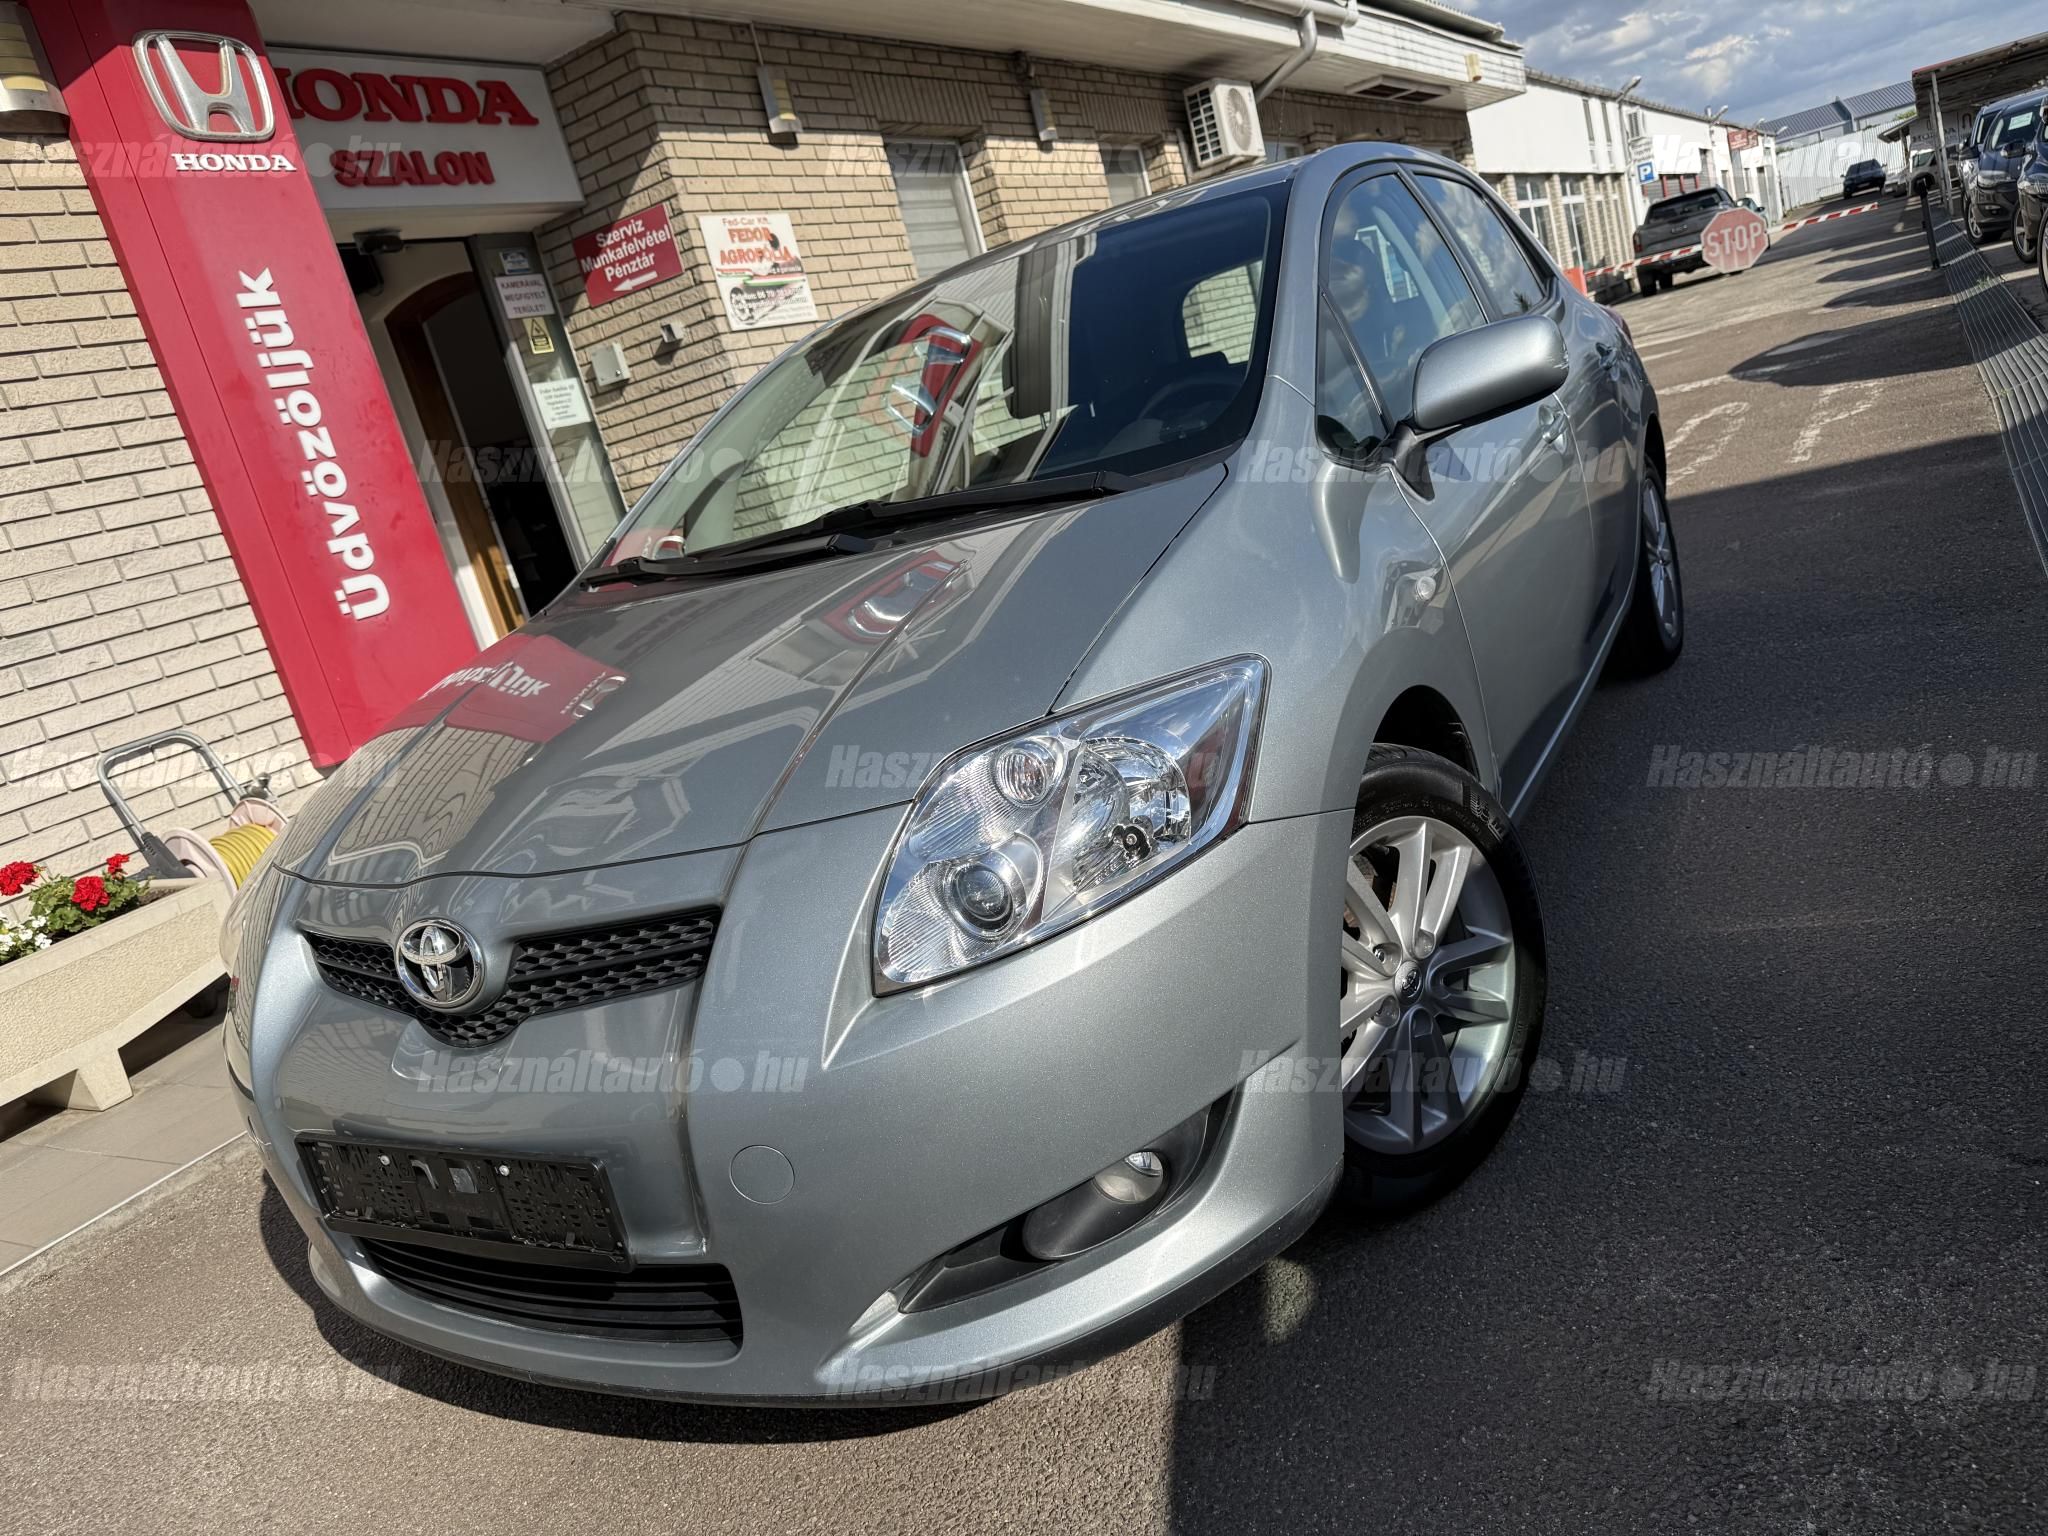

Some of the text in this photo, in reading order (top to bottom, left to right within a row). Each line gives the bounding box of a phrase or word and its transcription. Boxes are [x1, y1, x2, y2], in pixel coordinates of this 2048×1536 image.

[171, 152, 297, 172] HONDA
[331, 150, 495, 187] SZALON
[581, 224, 671, 273] Munkafelvétel
[596, 219, 645, 248] Szerviz
[1707, 222, 1762, 258] STOP
[604, 252, 656, 282] Pénztár
[236, 267, 391, 621] Üdvözöljük
